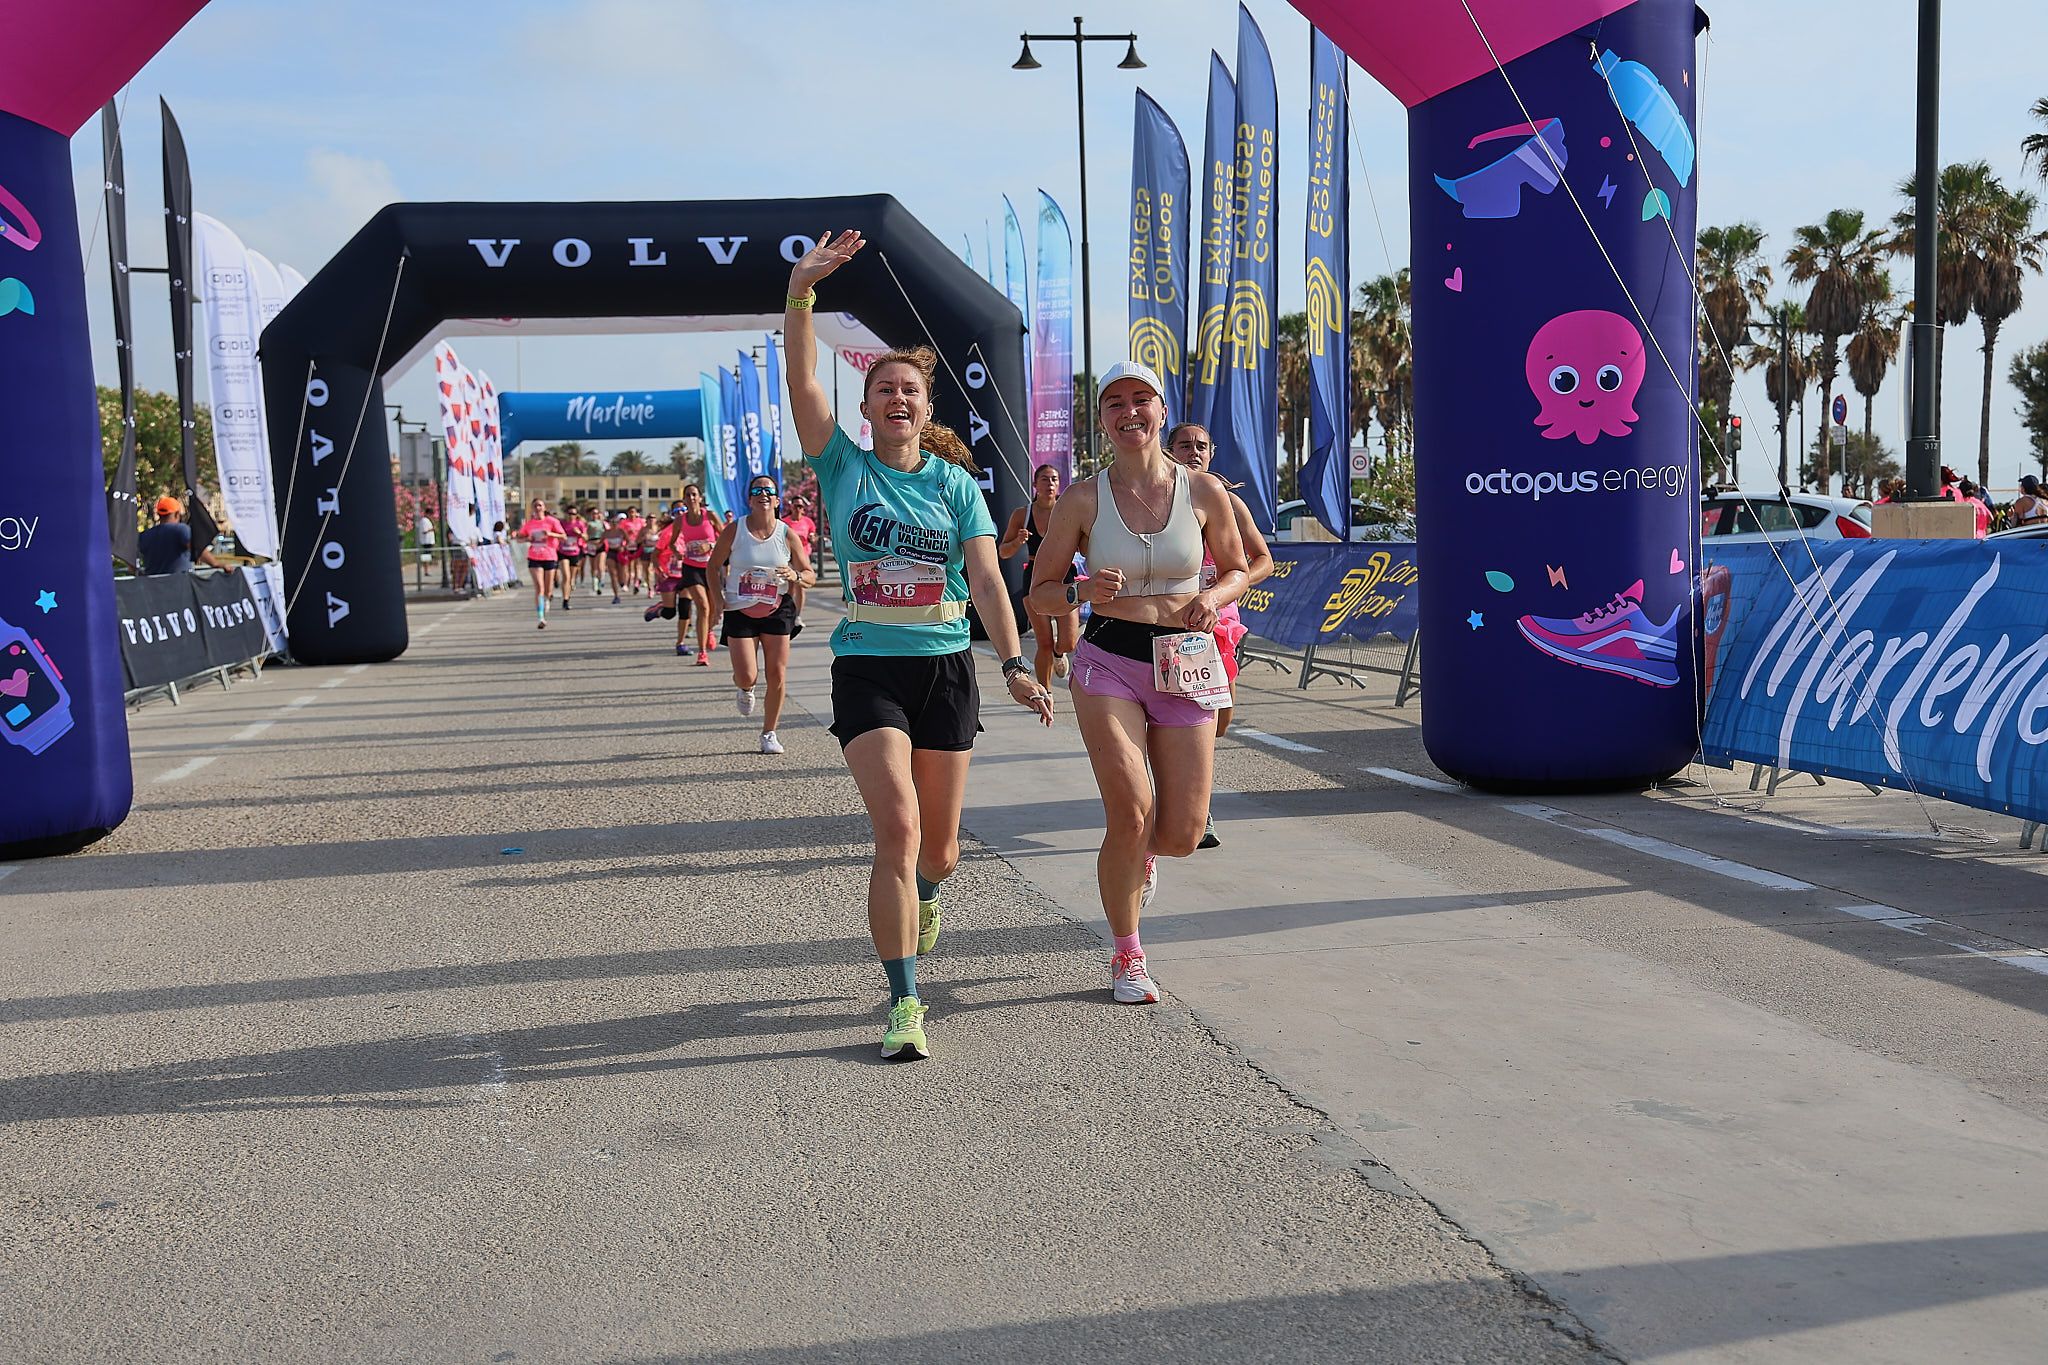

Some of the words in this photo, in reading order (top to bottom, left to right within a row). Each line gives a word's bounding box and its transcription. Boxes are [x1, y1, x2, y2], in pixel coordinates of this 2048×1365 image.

[468, 234, 818, 268] VOLVO
[566, 394, 655, 434] Marlene
[1465, 469, 1598, 500] octopus
[1602, 464, 1688, 497] energy
[308, 378, 350, 628] VOLVO
[854, 513, 897, 548] 15K
[897, 532, 950, 551] VALENCIA
[898, 522, 949, 540] NOCTURNA
[881, 584, 916, 597] 016
[122, 607, 197, 645] VOLVO
[202, 598, 256, 628] VOLVO
[1182, 667, 1211, 683] 016
